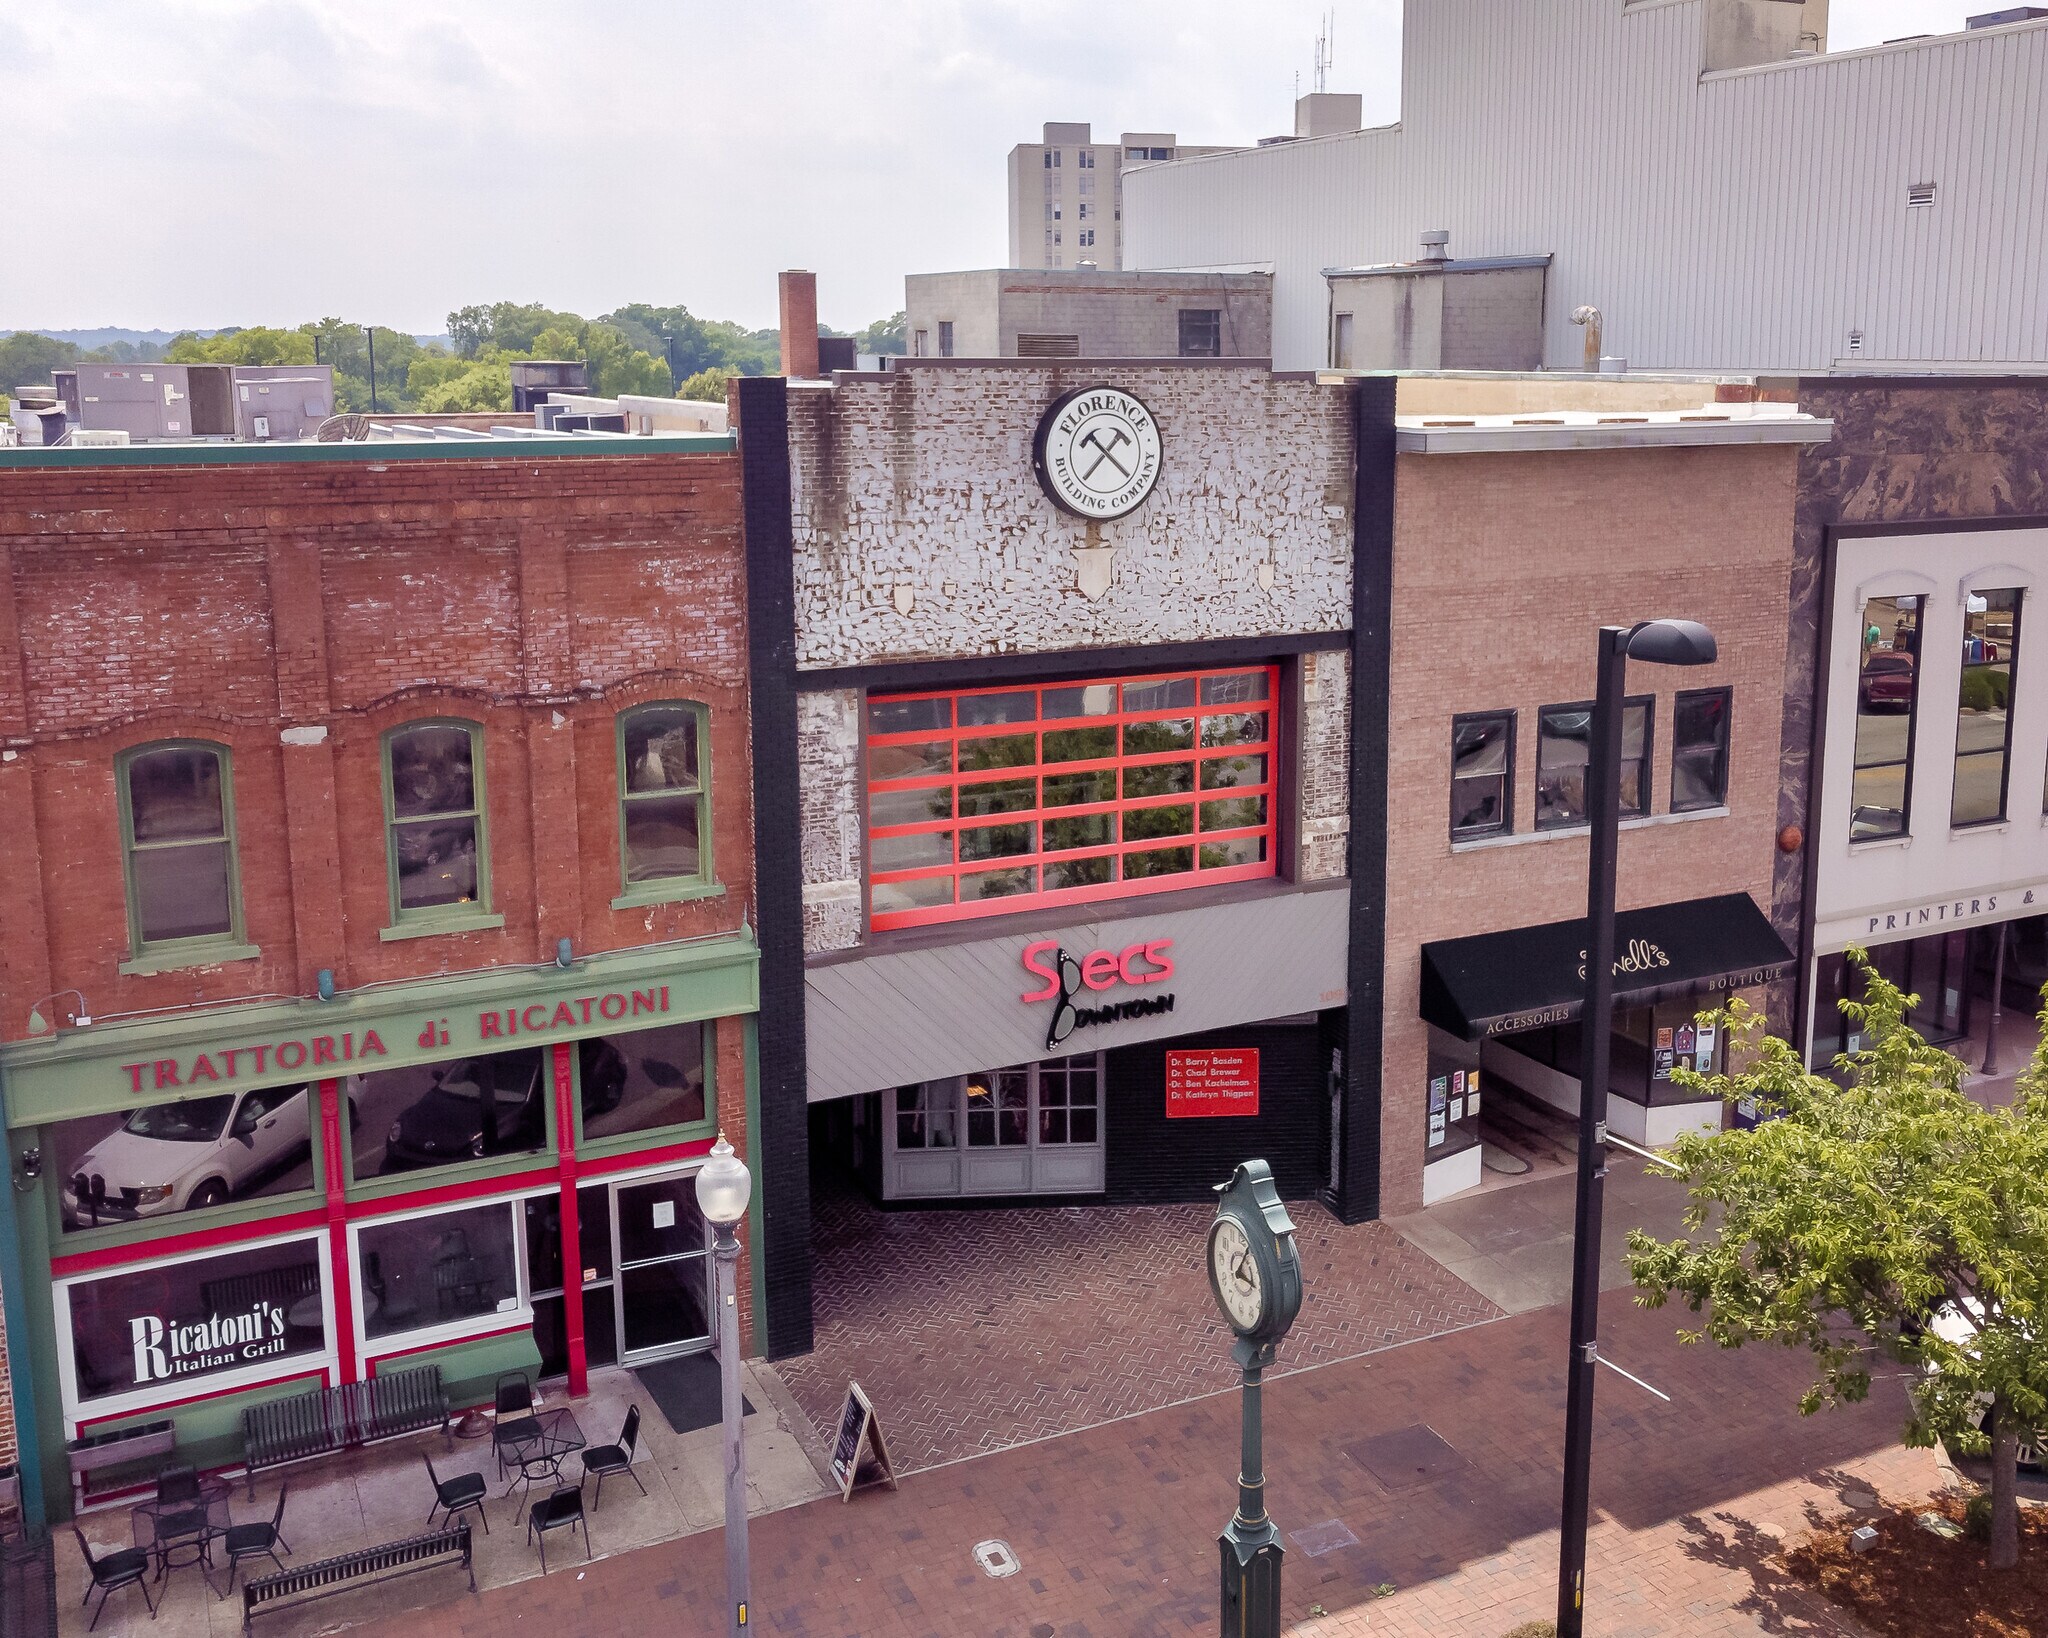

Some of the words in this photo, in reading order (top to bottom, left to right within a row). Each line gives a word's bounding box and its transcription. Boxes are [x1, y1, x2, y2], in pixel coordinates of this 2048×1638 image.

[1059, 395, 1151, 437] FLORENCE
[1054, 456, 1107, 510] BUILDING
[1111, 452, 1156, 508] COMPANY
[1868, 896, 1998, 934] PRINTERS
[2023, 889, 2036, 905] &
[1021, 938, 1175, 1006] Specs
[1707, 967, 1784, 992] BOUTIQUE
[121, 1030, 388, 1095] TRATTORIA
[418, 1019, 451, 1050] di
[479, 985, 673, 1041] RICATONI
[1485, 1008, 1572, 1036] ACCESSORIES
[1171, 1058, 1183, 1066] Dr.
[1186, 1058, 1209, 1067] Barry
[1171, 1069, 1183, 1077] Dr.
[1186, 1069, 1207, 1077] Chad
[1210, 1068, 1240, 1076] Brewer
[1171, 1080, 1183, 1088] Dr.
[1186, 1080, 1202, 1088] Ben
[1171, 1091, 1183, 1099] Dr.
[1186, 1091, 1219, 1100] Kathryn
[1222, 1089, 1254, 1099] Thigpen
[128, 1302, 285, 1385] Ricatoni's
[173, 1348, 236, 1375] Italian
[242, 1337, 287, 1361] Grill
